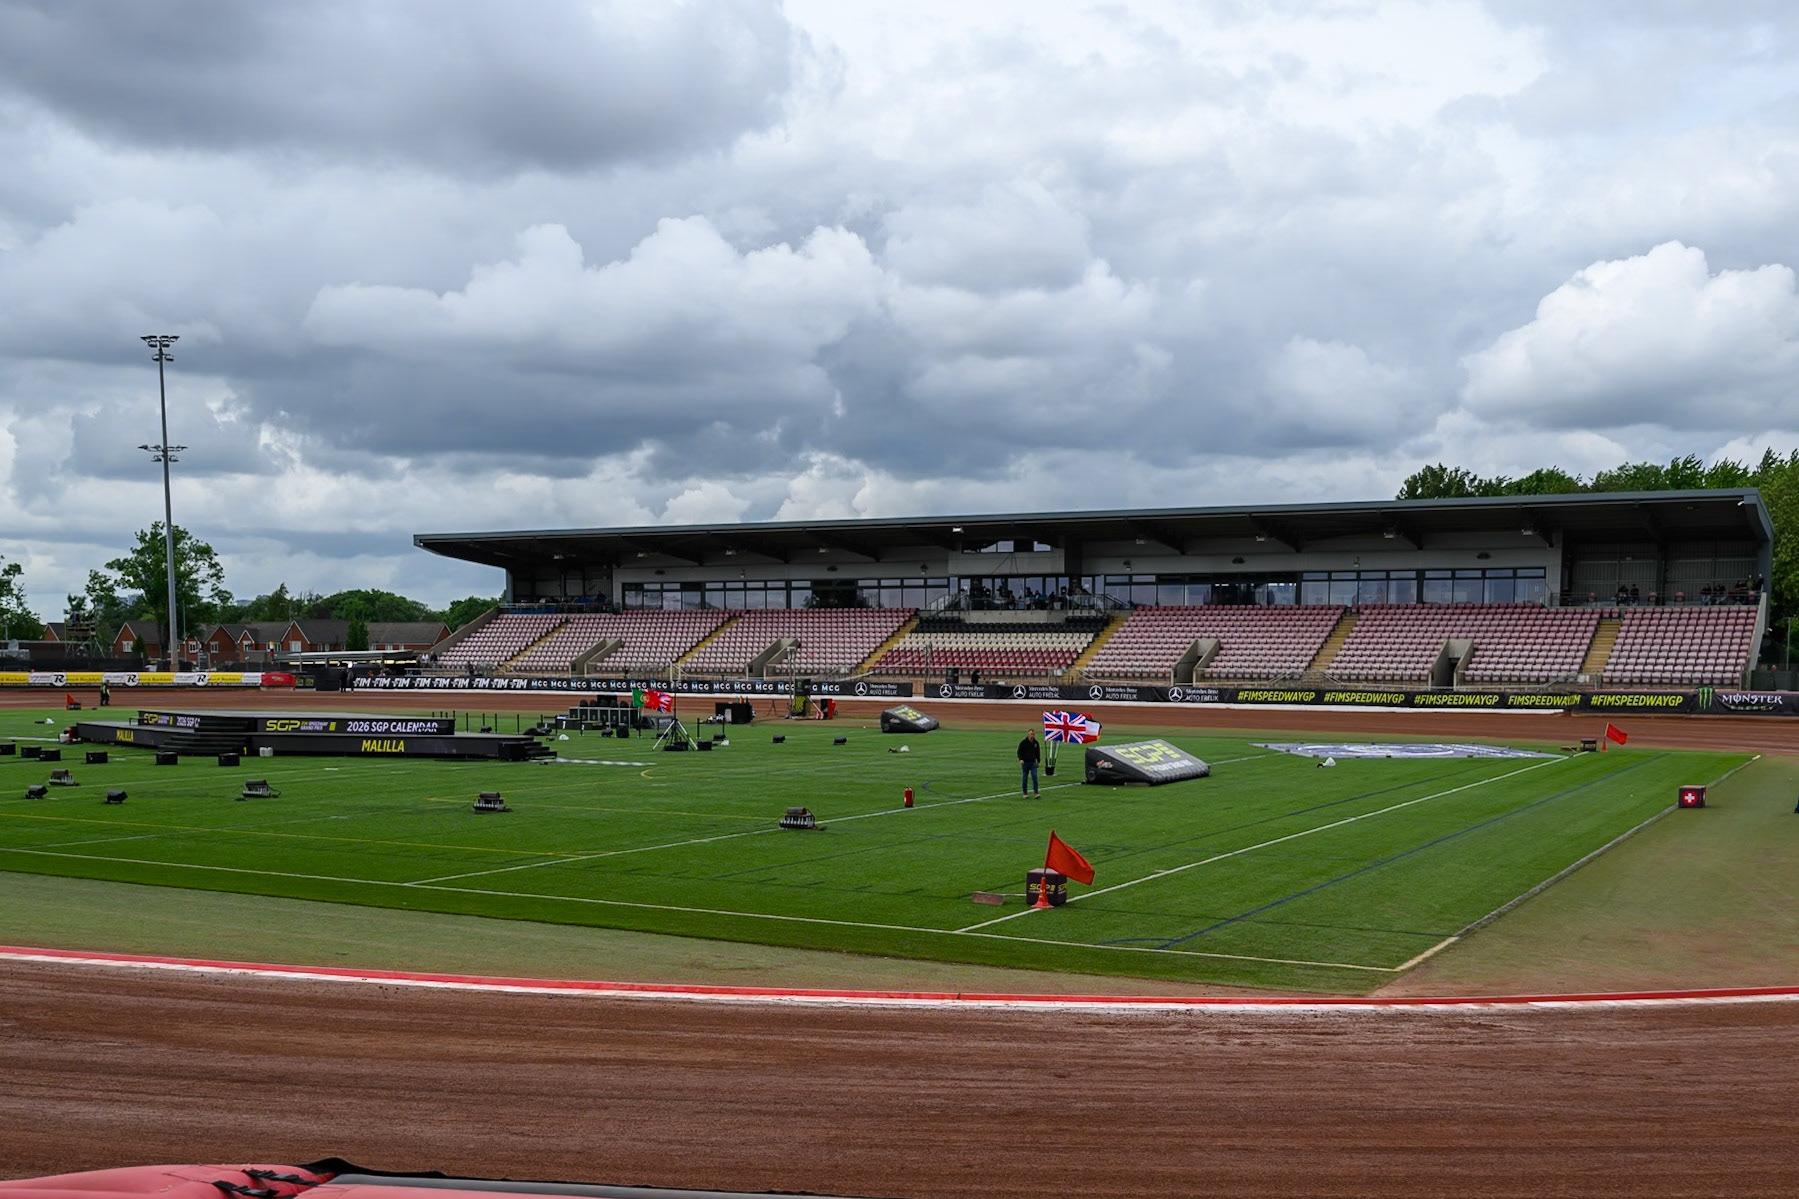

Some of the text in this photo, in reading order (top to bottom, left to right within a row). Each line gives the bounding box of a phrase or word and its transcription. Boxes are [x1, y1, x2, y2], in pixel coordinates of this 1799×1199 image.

[1238, 691, 1315, 702] #FIMSPEEDWAYGP
[1324, 692, 1404, 704] #FIMSPEEDWAYGP
[1414, 694, 1499, 705] #FIMSPEEDWAYGP
[1591, 695, 1683, 706] #FIMSPEEDWAYGP
[266, 720, 300, 731] SGP
[347, 721, 438, 733] 2026 SGP CALENDAR
[361, 740, 405, 752] MALILLA
